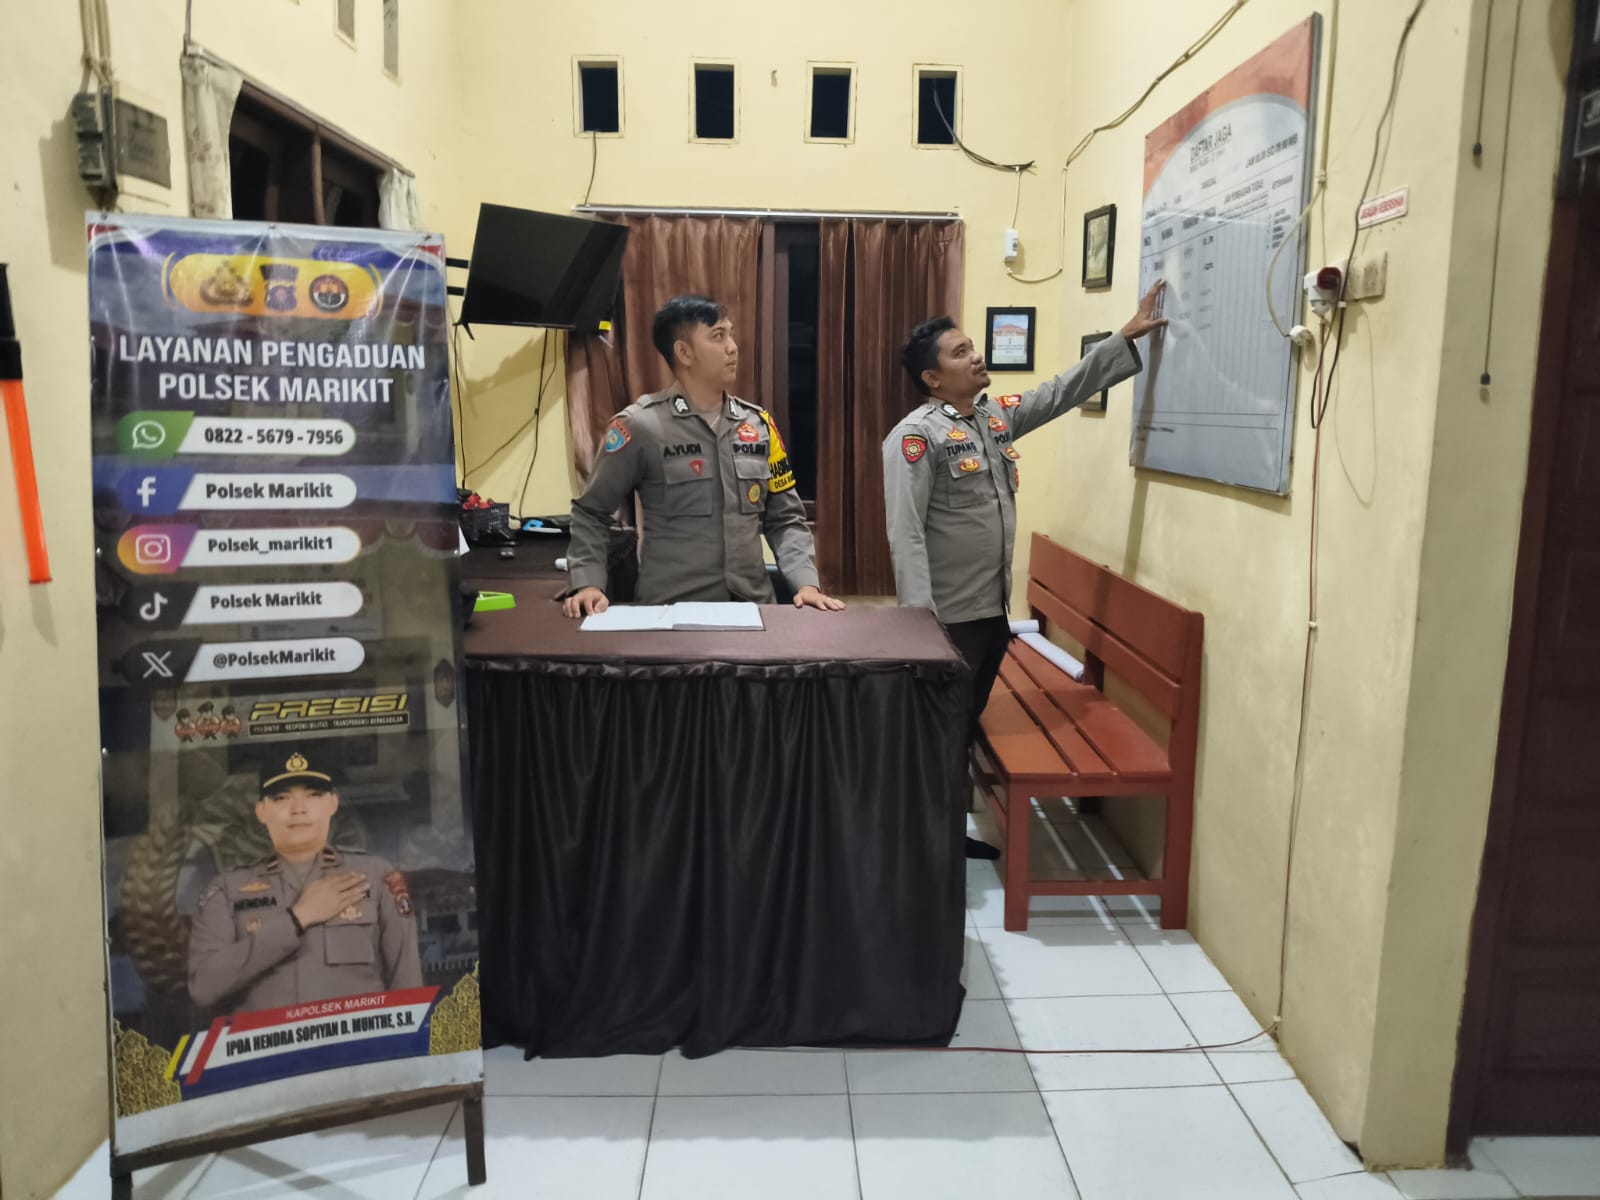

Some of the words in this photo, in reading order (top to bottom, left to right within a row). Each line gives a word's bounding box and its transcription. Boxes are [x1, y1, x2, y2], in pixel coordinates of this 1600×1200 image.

[119, 335, 252, 365] LAYANAN
[262, 341, 425, 370] PENGADUAN
[159, 373, 271, 401] POLSEK
[279, 377, 394, 403] MARIKIT
[204, 427, 243, 444] 0822
[256, 428, 294, 445] 5679
[307, 429, 344, 446] 7956
[206, 482, 264, 499] Polsek
[268, 482, 333, 499] Marikit
[207, 536, 333, 554] Polsek_marikit1
[210, 593, 262, 609] Polsek
[265, 591, 323, 607] Marikit
[213, 648, 336, 669] @PolsekMarikit
[249, 693, 408, 721] PRESISI
[286, 1003, 342, 1018] KAPOLSEK
[344, 995, 387, 1009] MARIKIT
[226, 1040, 252, 1057] IPDA
[253, 1029, 294, 1052] HENDRA
[296, 1021, 339, 1043] SOPIYAN
[341, 1019, 350, 1034] D.
[397, 1011, 415, 1026] S.H.
